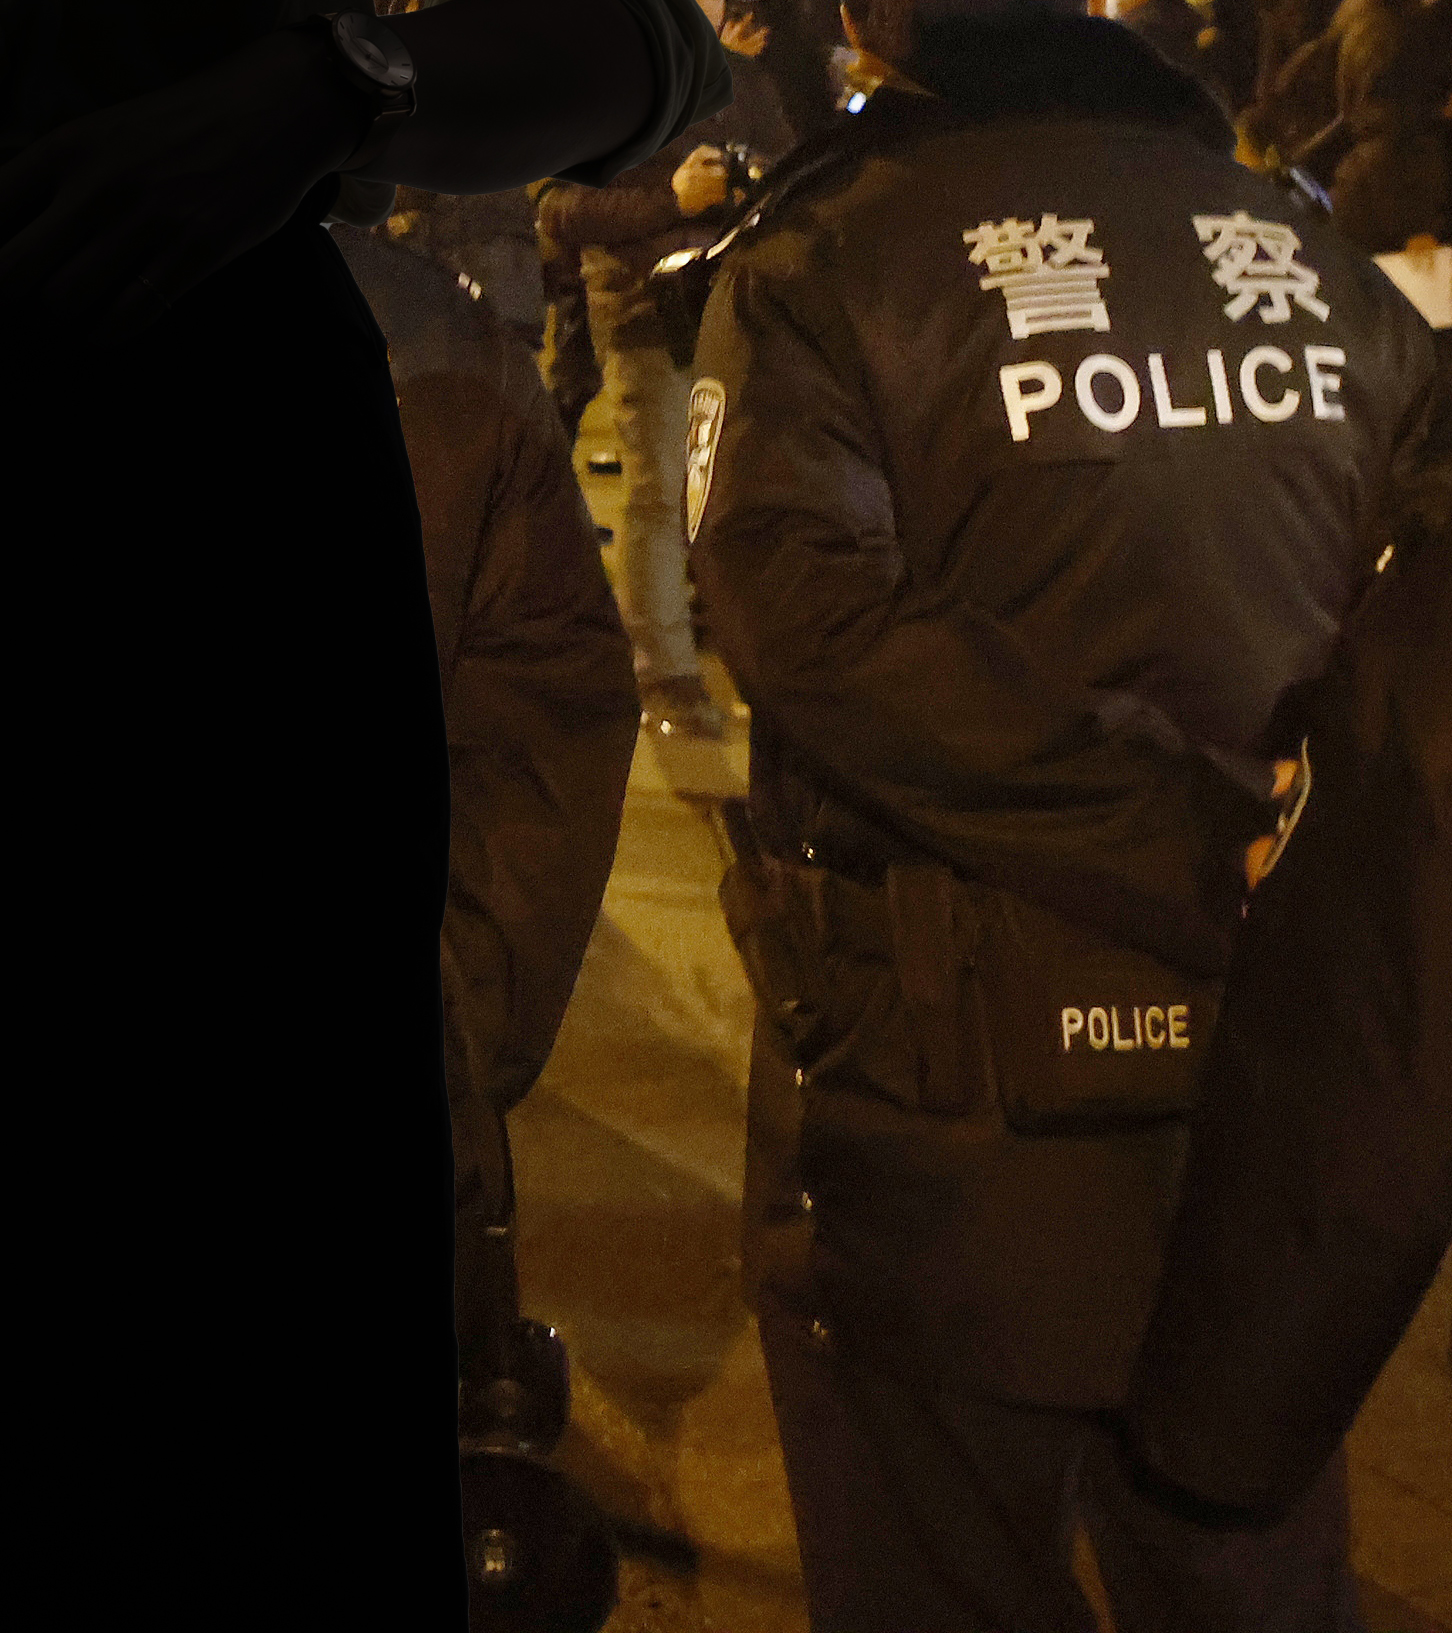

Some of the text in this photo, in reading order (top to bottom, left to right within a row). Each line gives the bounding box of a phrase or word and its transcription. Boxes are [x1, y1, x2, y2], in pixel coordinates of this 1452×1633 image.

[963, 210, 1331, 341] 警察
[1000, 346, 1347, 443] POLICE
[1061, 1002, 1192, 1055] POLICE
